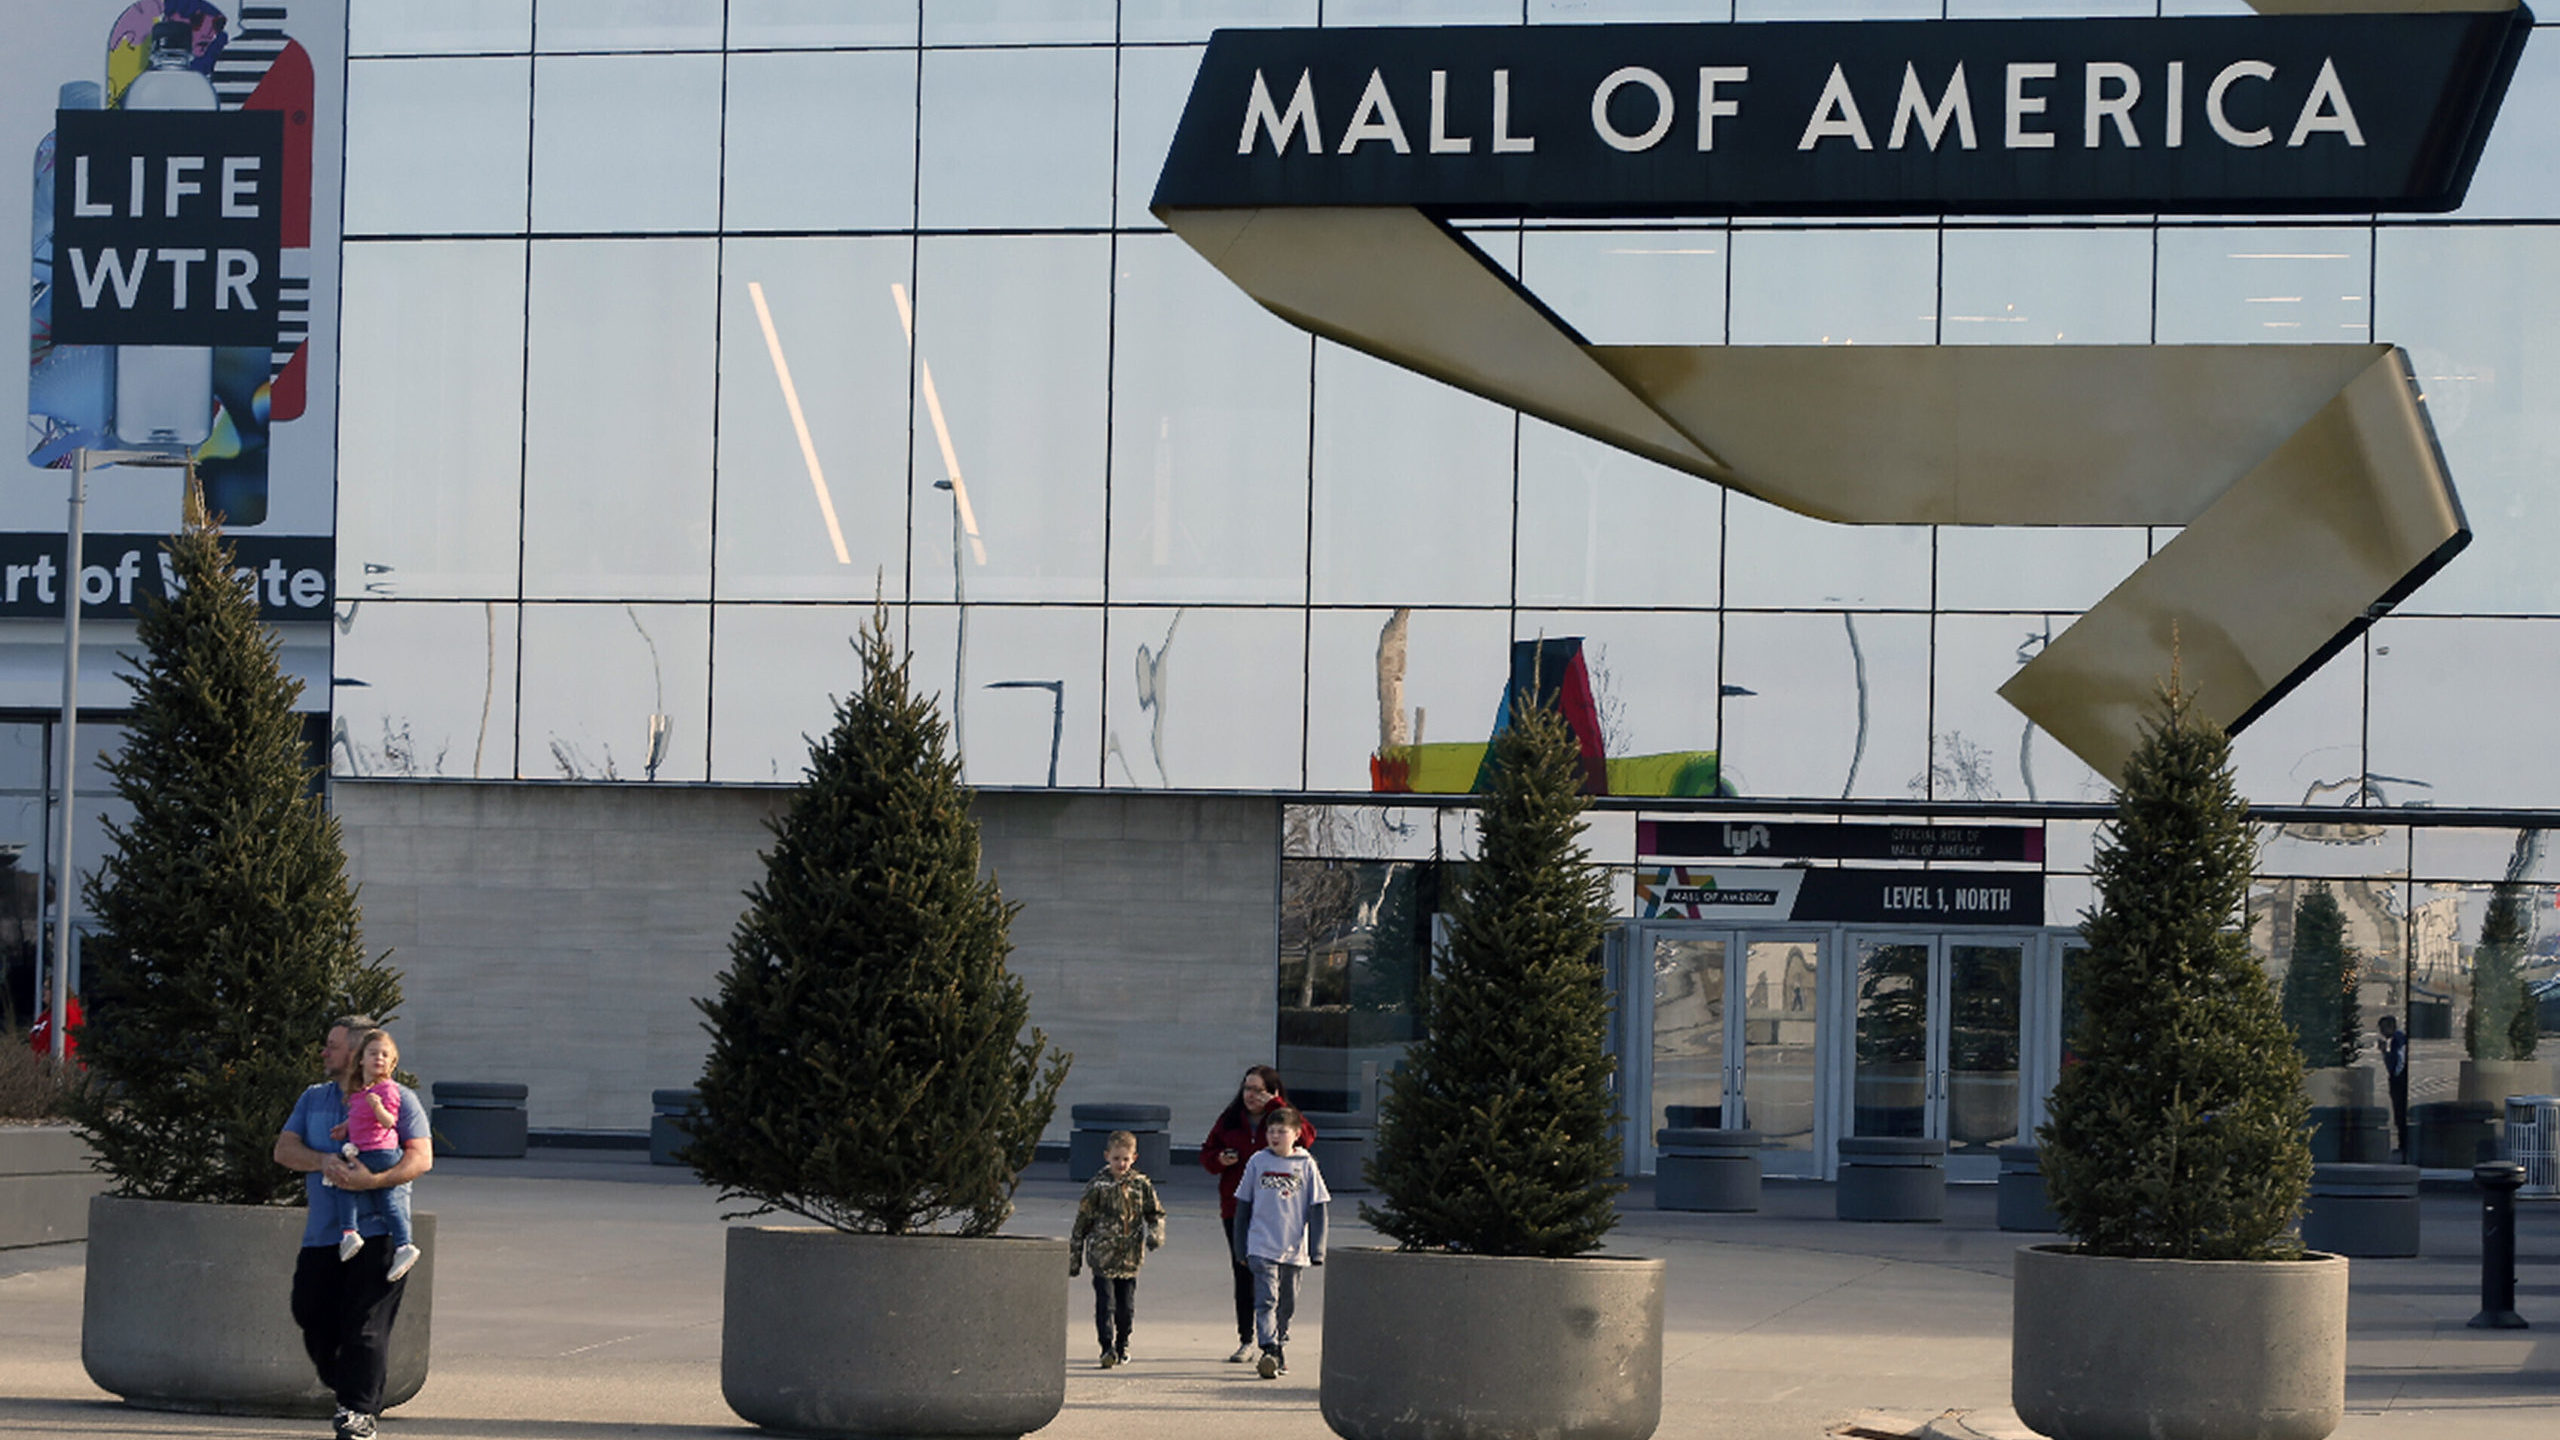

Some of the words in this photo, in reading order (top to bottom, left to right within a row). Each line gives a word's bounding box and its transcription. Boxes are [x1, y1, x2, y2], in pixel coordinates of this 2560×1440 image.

[1238, 68, 1534, 156] MALL
[1592, 67, 1748, 151] OF
[1798, 58, 2365, 151] AMERICA
[75, 156, 260, 217] LIFE
[69, 248, 258, 309] WTR
[0, 554, 57, 605] rt
[79, 550, 141, 605] of
[154, 553, 331, 608] ate
[1891, 844, 1918, 856] MALL
[1921, 844, 1934, 856] OF
[1671, 891, 1700, 902] MALL
[1703, 892, 1718, 902] OF
[1722, 892, 1771, 902] AMERICA
[1883, 886, 1932, 909] LEVEL
[1936, 887, 1949, 913] 1,
[1955, 888, 2011, 911] NORTH
